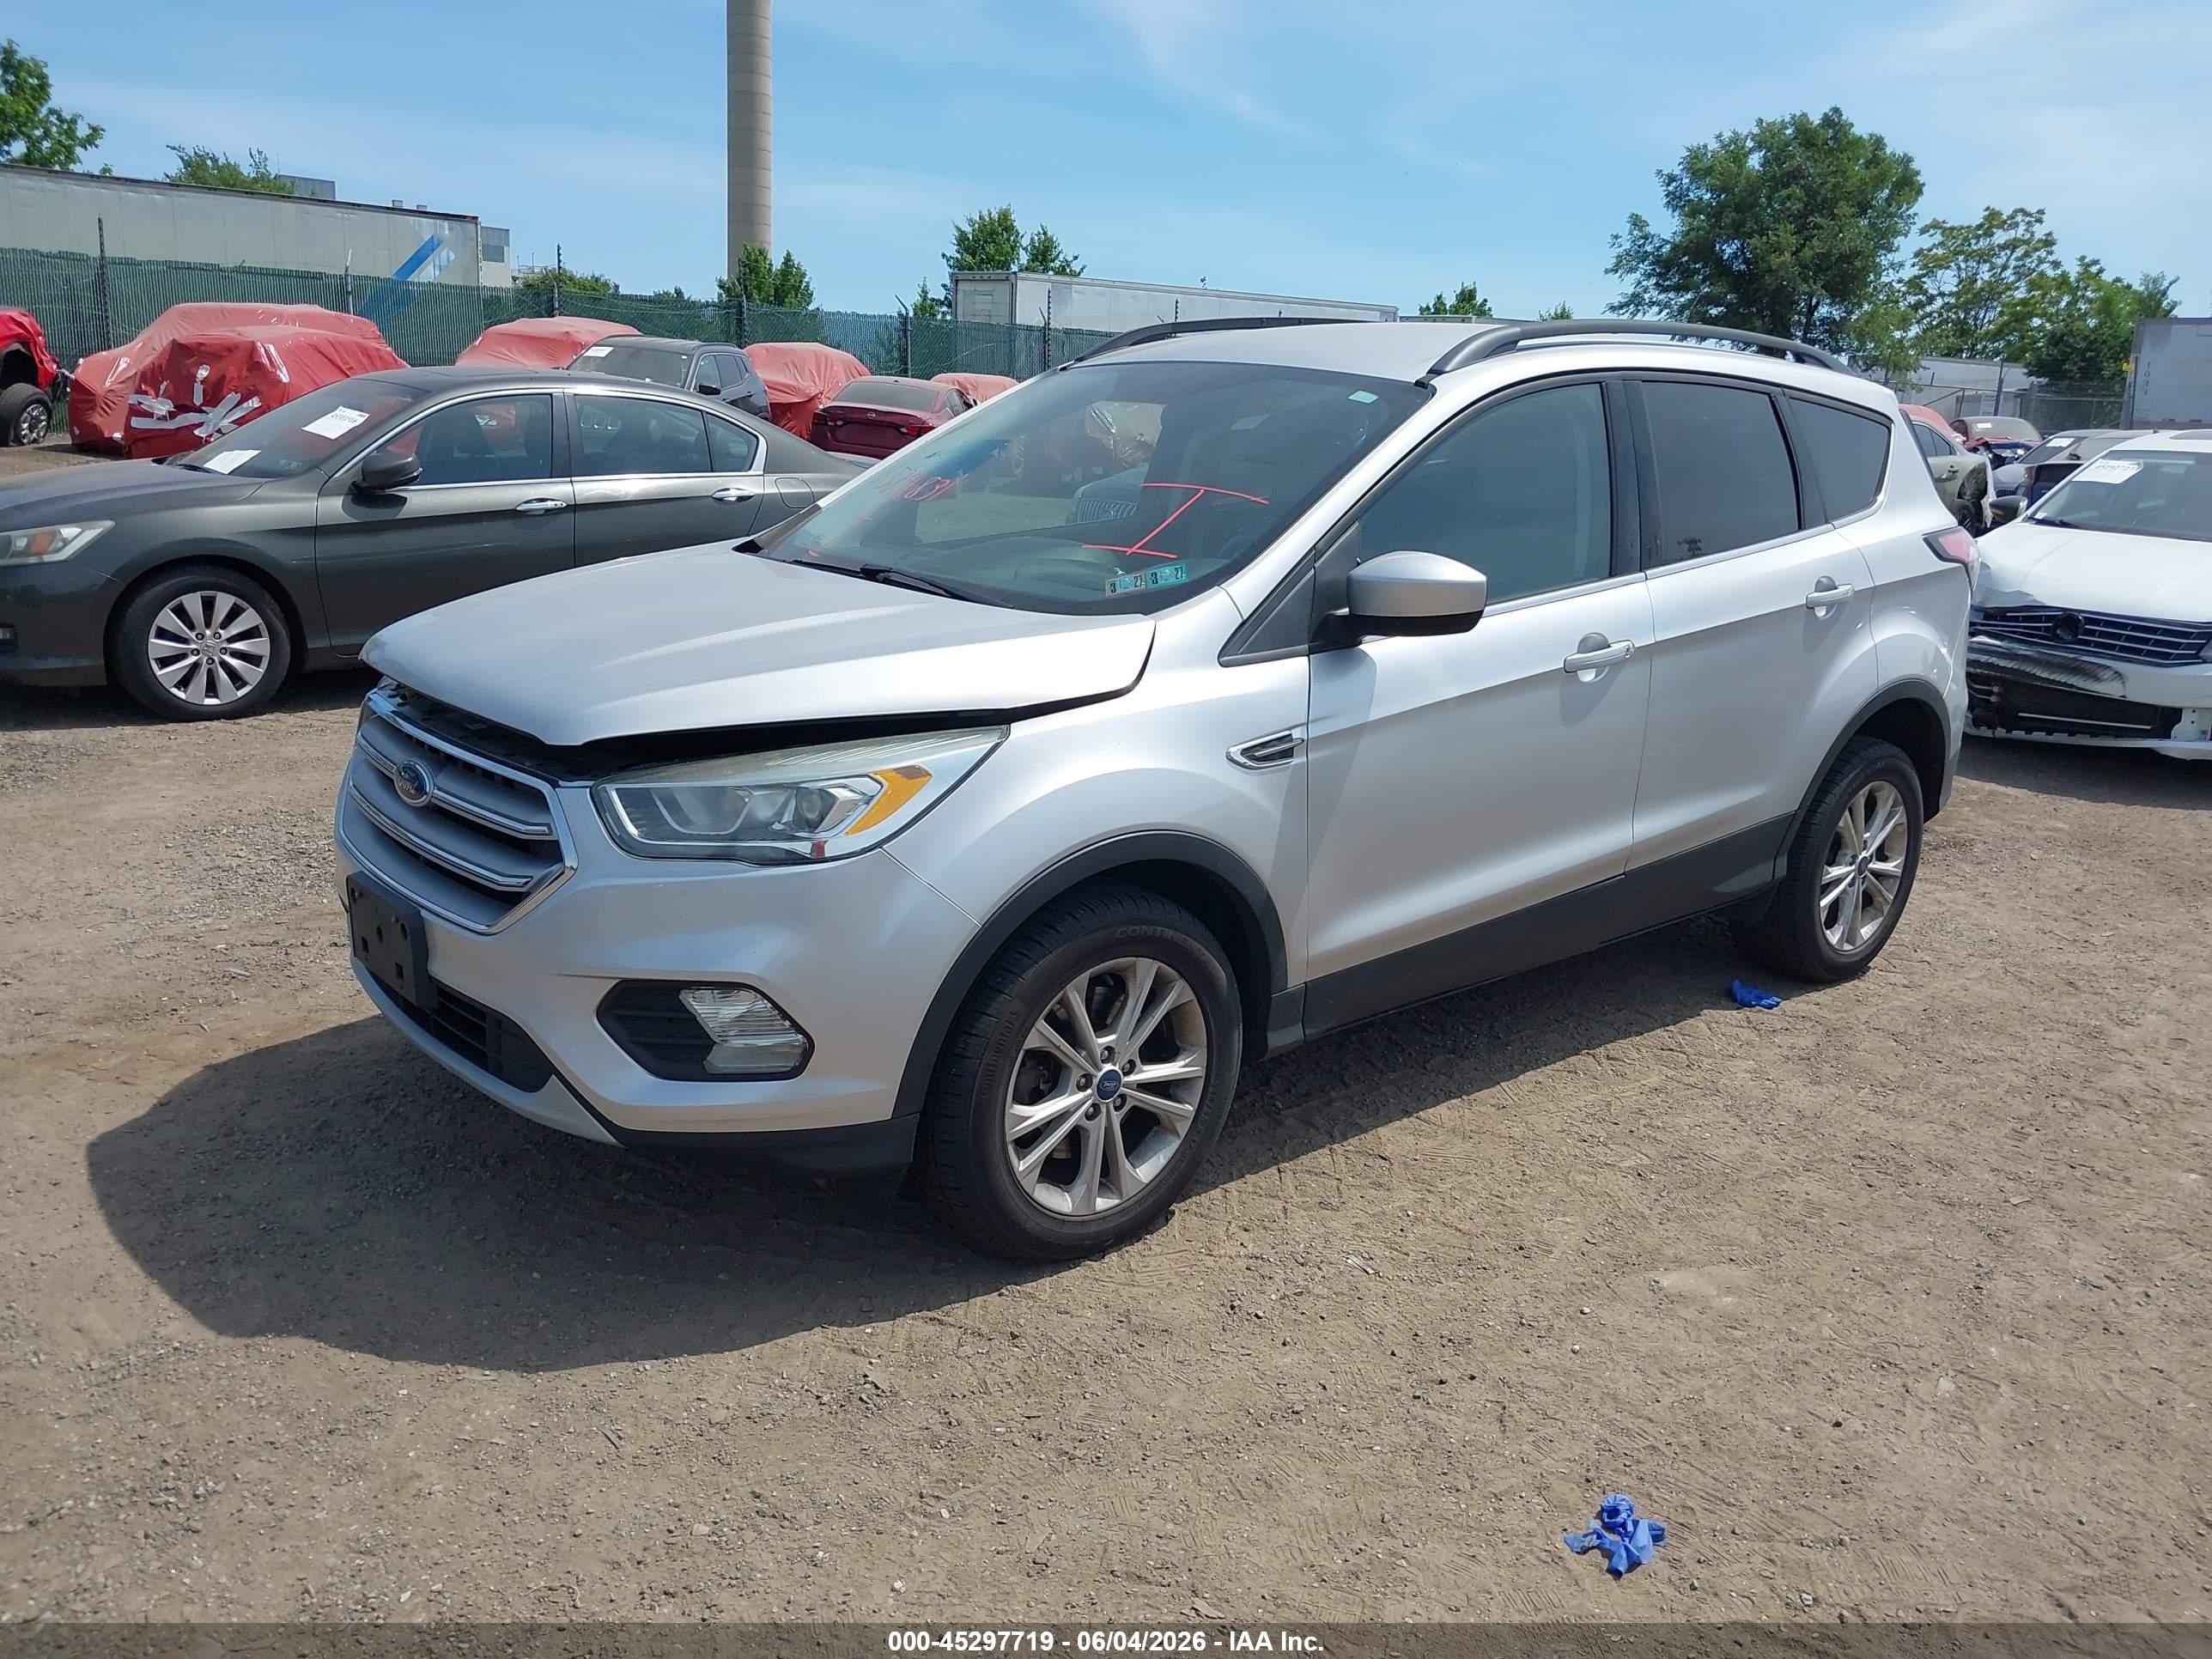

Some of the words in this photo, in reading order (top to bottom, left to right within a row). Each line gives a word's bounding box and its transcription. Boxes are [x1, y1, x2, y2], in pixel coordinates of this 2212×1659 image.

[1109, 582, 1117, 593] 3
[1133, 574, 1143, 588] 27
[1151, 571, 1158, 585] 3
[1174, 566, 1183, 580] 27
